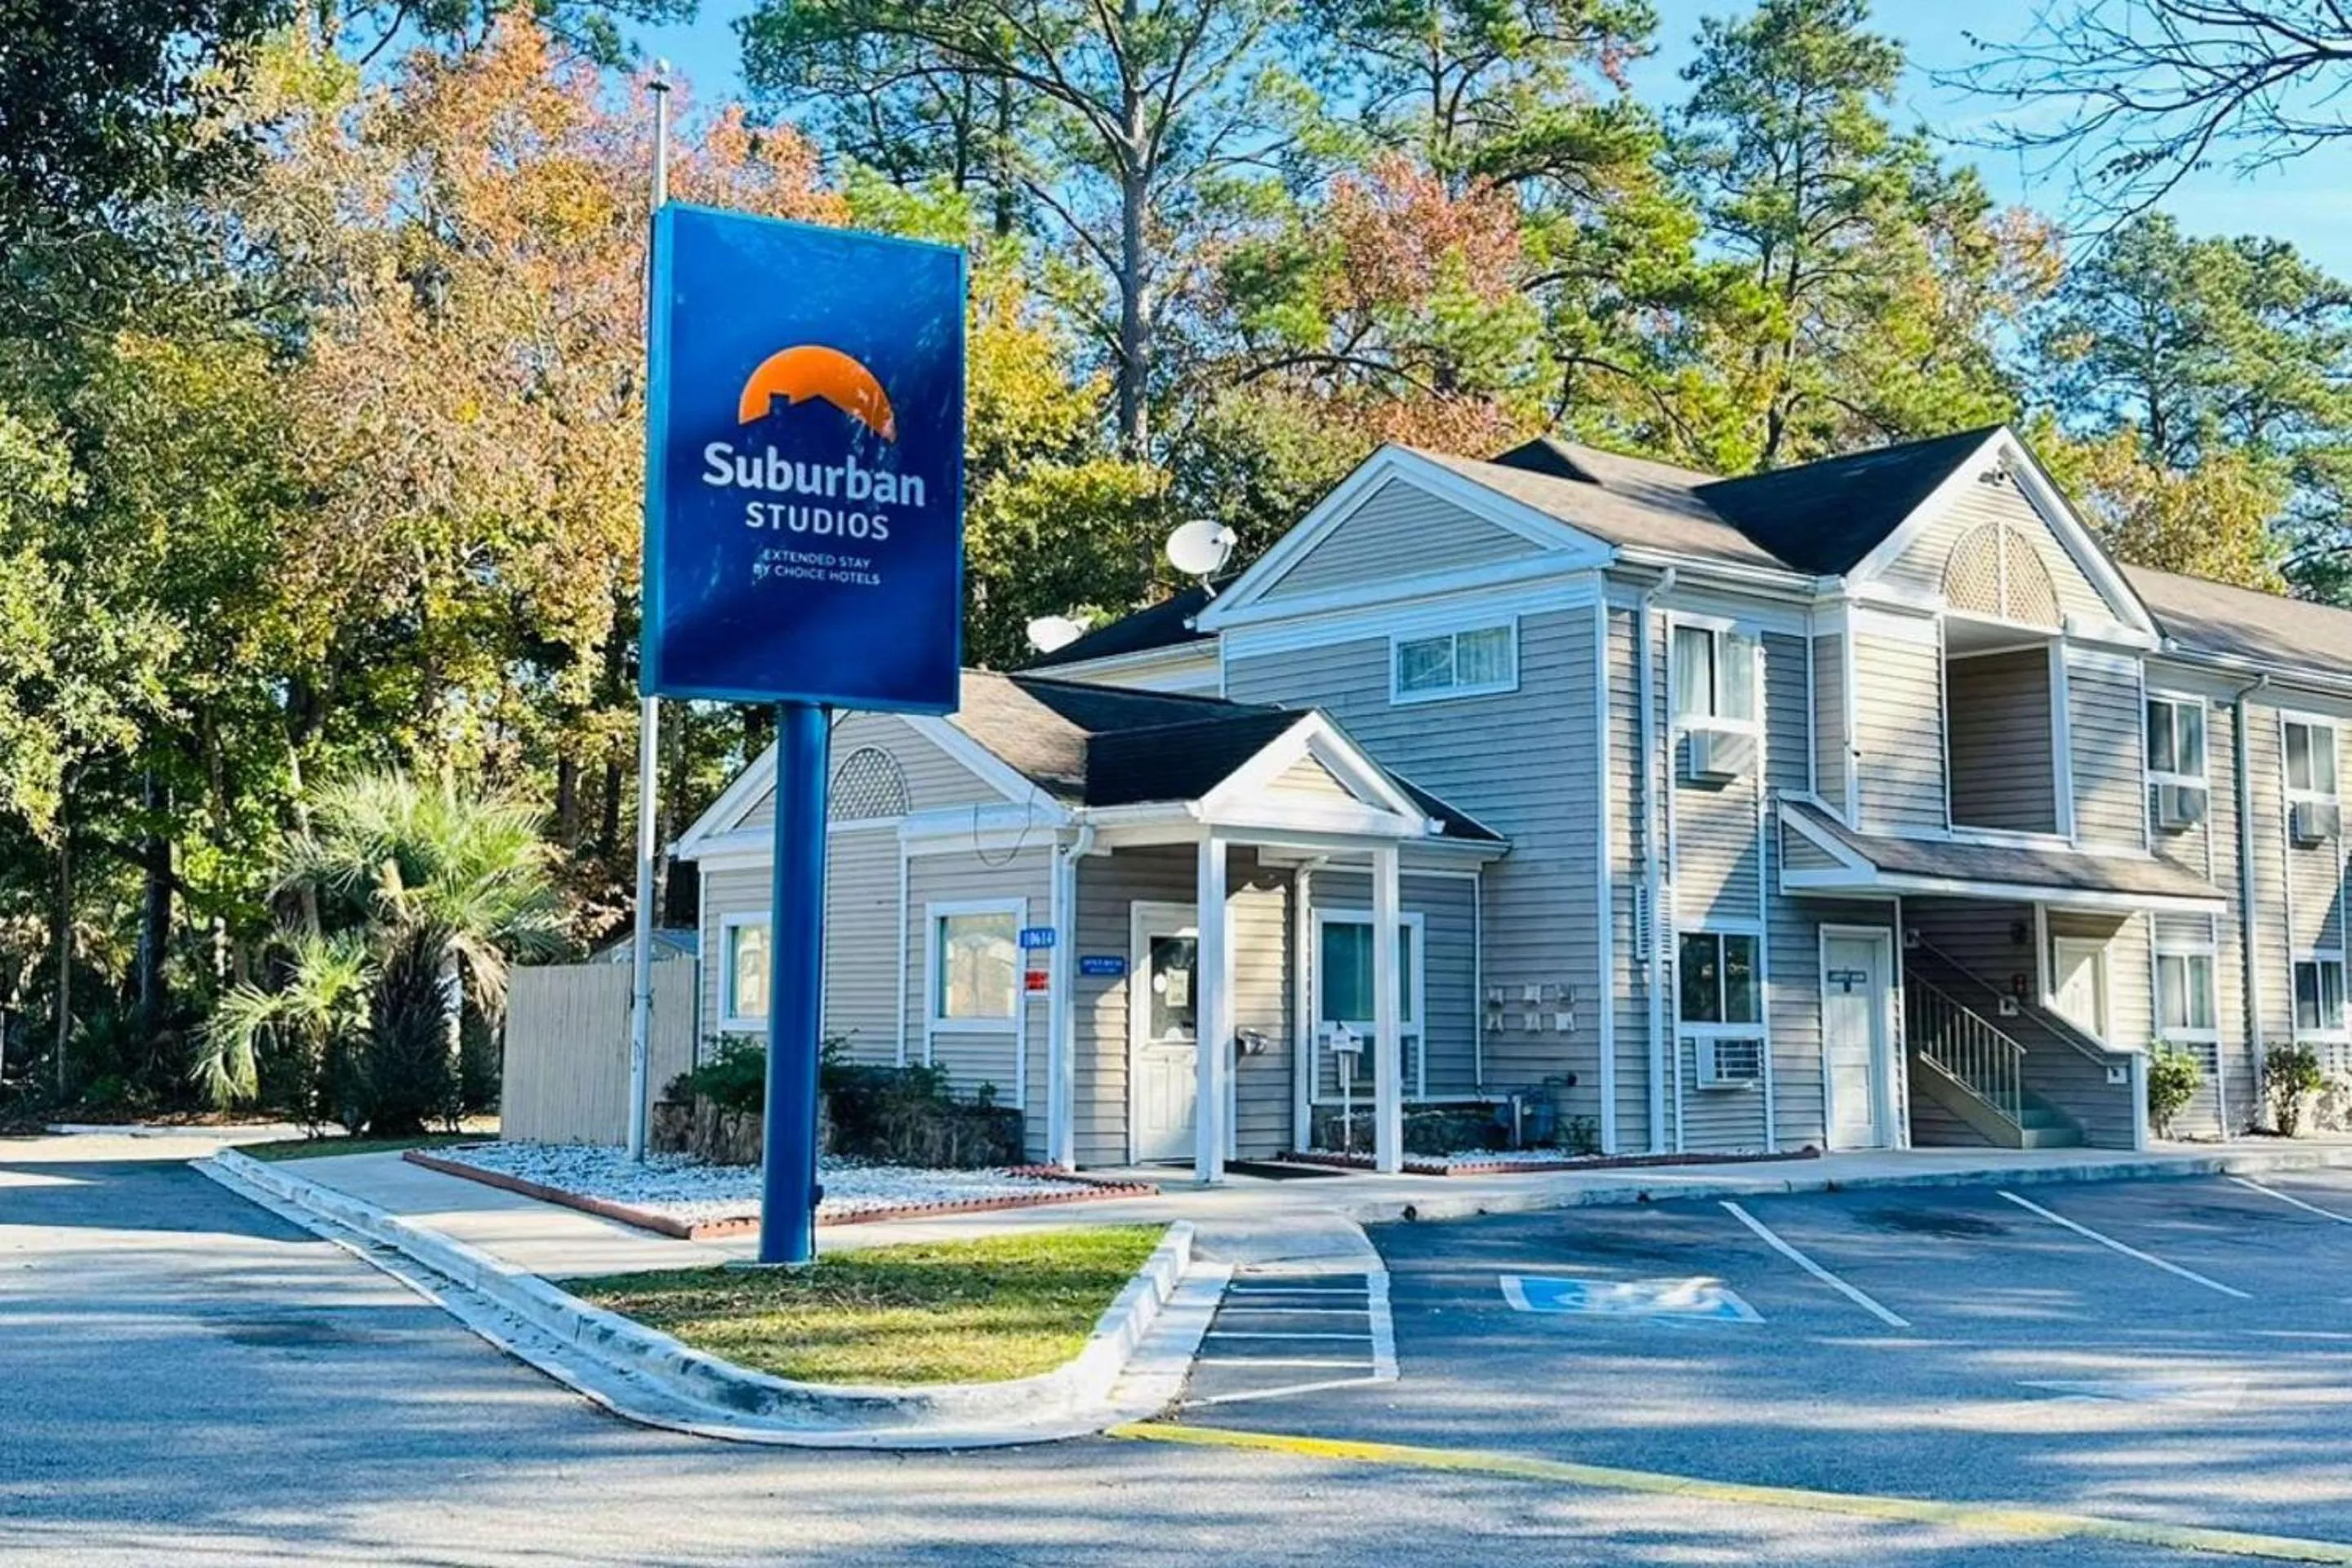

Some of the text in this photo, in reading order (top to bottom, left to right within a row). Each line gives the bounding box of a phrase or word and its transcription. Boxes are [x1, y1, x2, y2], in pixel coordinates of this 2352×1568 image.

[702, 441, 925, 508] Suburban
[745, 501, 889, 541] STUDIOS
[763, 548, 871, 569] EXTENDED STAY
[752, 563, 881, 586] BY CHOICE HOTELS
